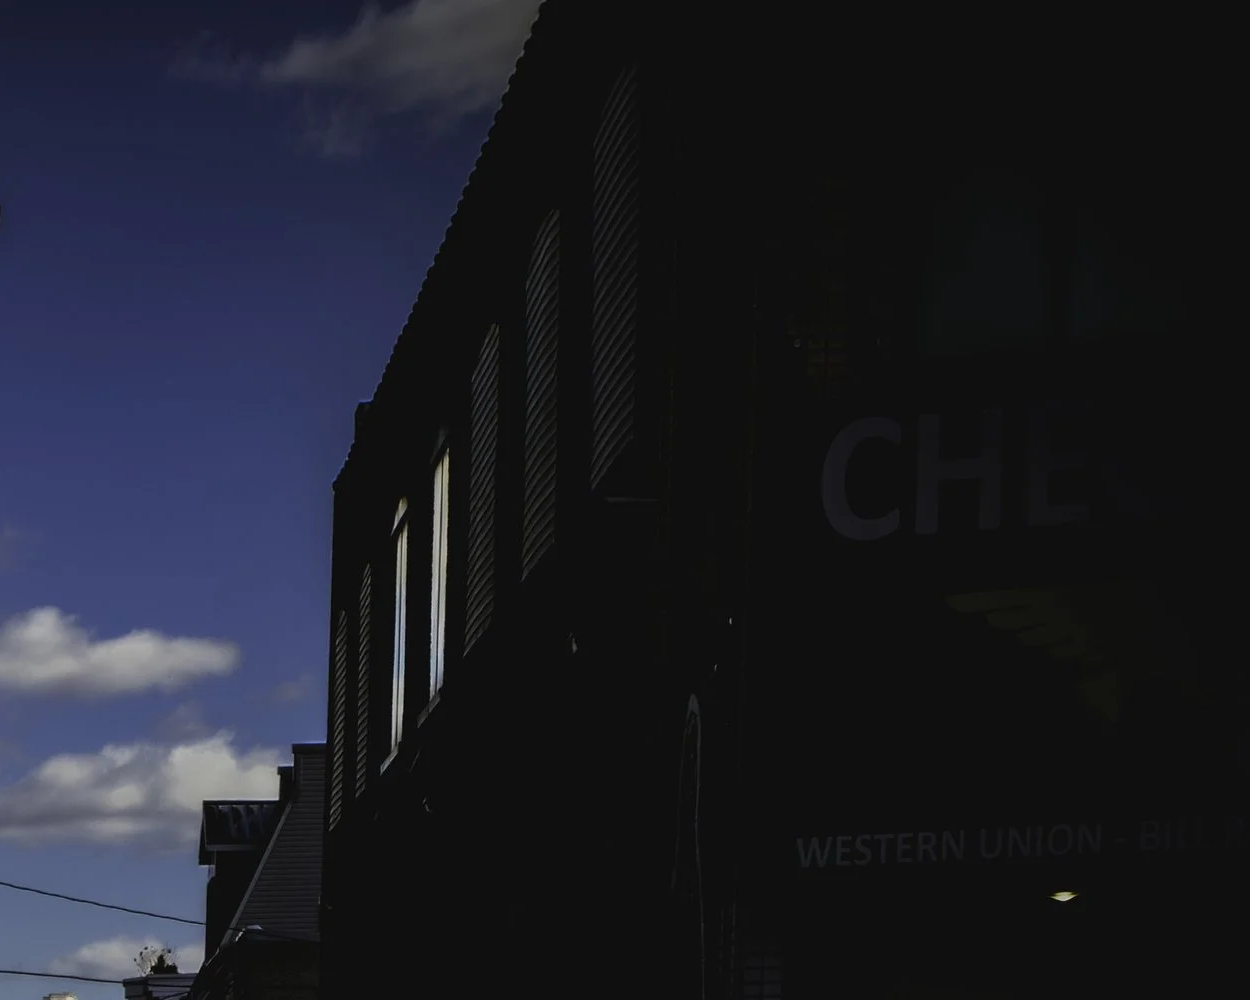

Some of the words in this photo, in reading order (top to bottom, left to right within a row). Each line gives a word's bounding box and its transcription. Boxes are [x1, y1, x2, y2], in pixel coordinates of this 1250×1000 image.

[795, 828, 965, 868] WESTERN
[980, 823, 1103, 860] UNION
[1138, 815, 1208, 851] BILL
